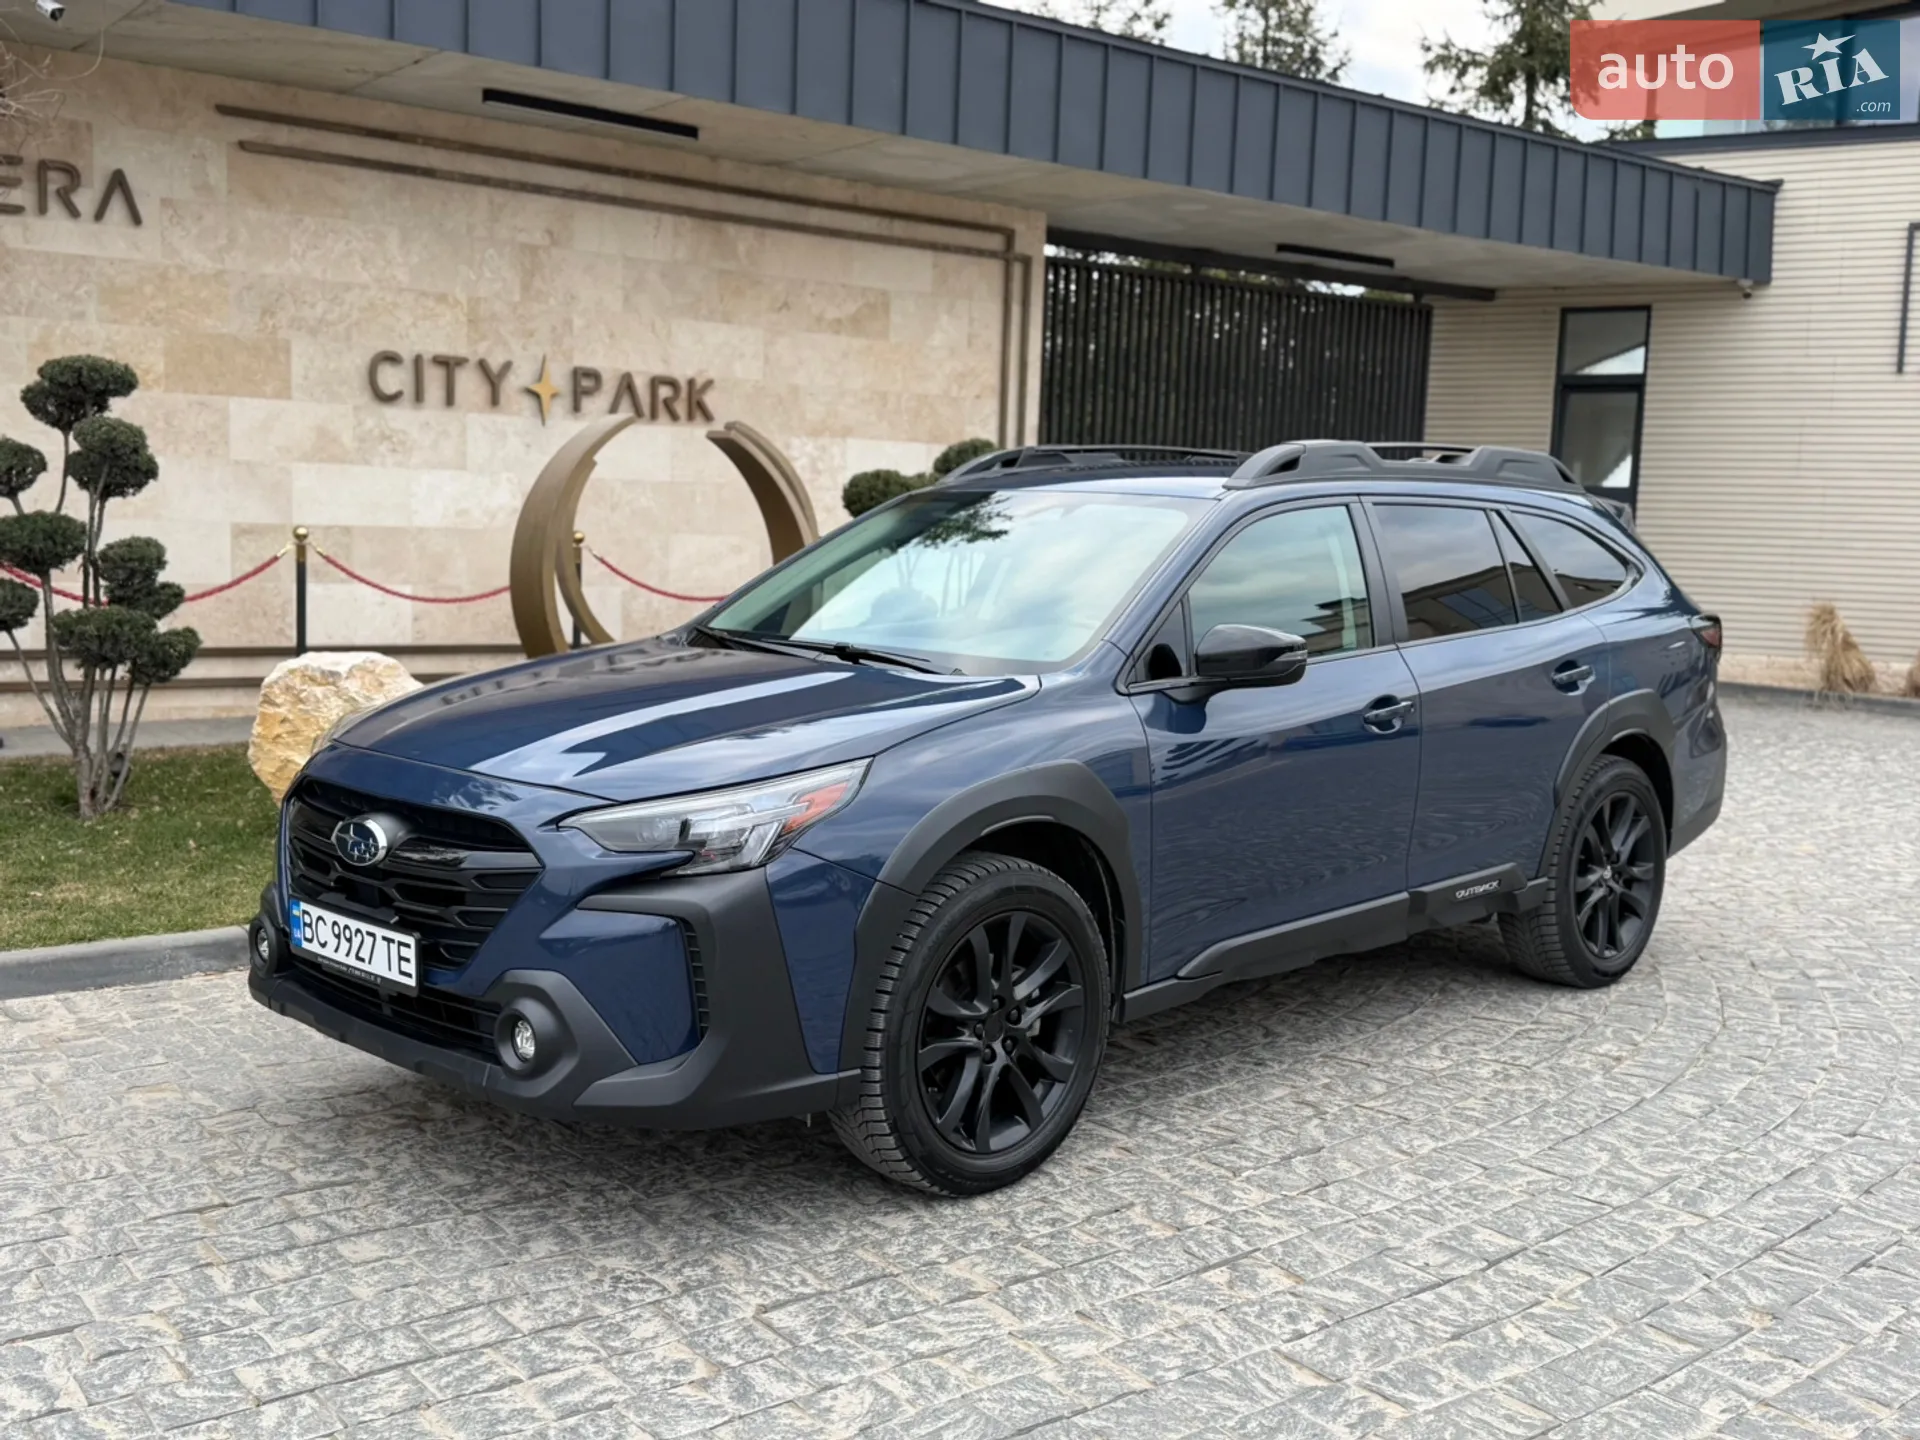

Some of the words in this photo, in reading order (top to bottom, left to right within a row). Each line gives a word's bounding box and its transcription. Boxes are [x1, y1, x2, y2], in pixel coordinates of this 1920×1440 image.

[368, 350, 514, 407] CITY
[572, 366, 715, 423] PARK
[1455, 880, 1500, 898] OUTBACK
[301, 909, 328, 949] BC
[331, 920, 377, 965] 9927
[381, 935, 413, 979] TE
